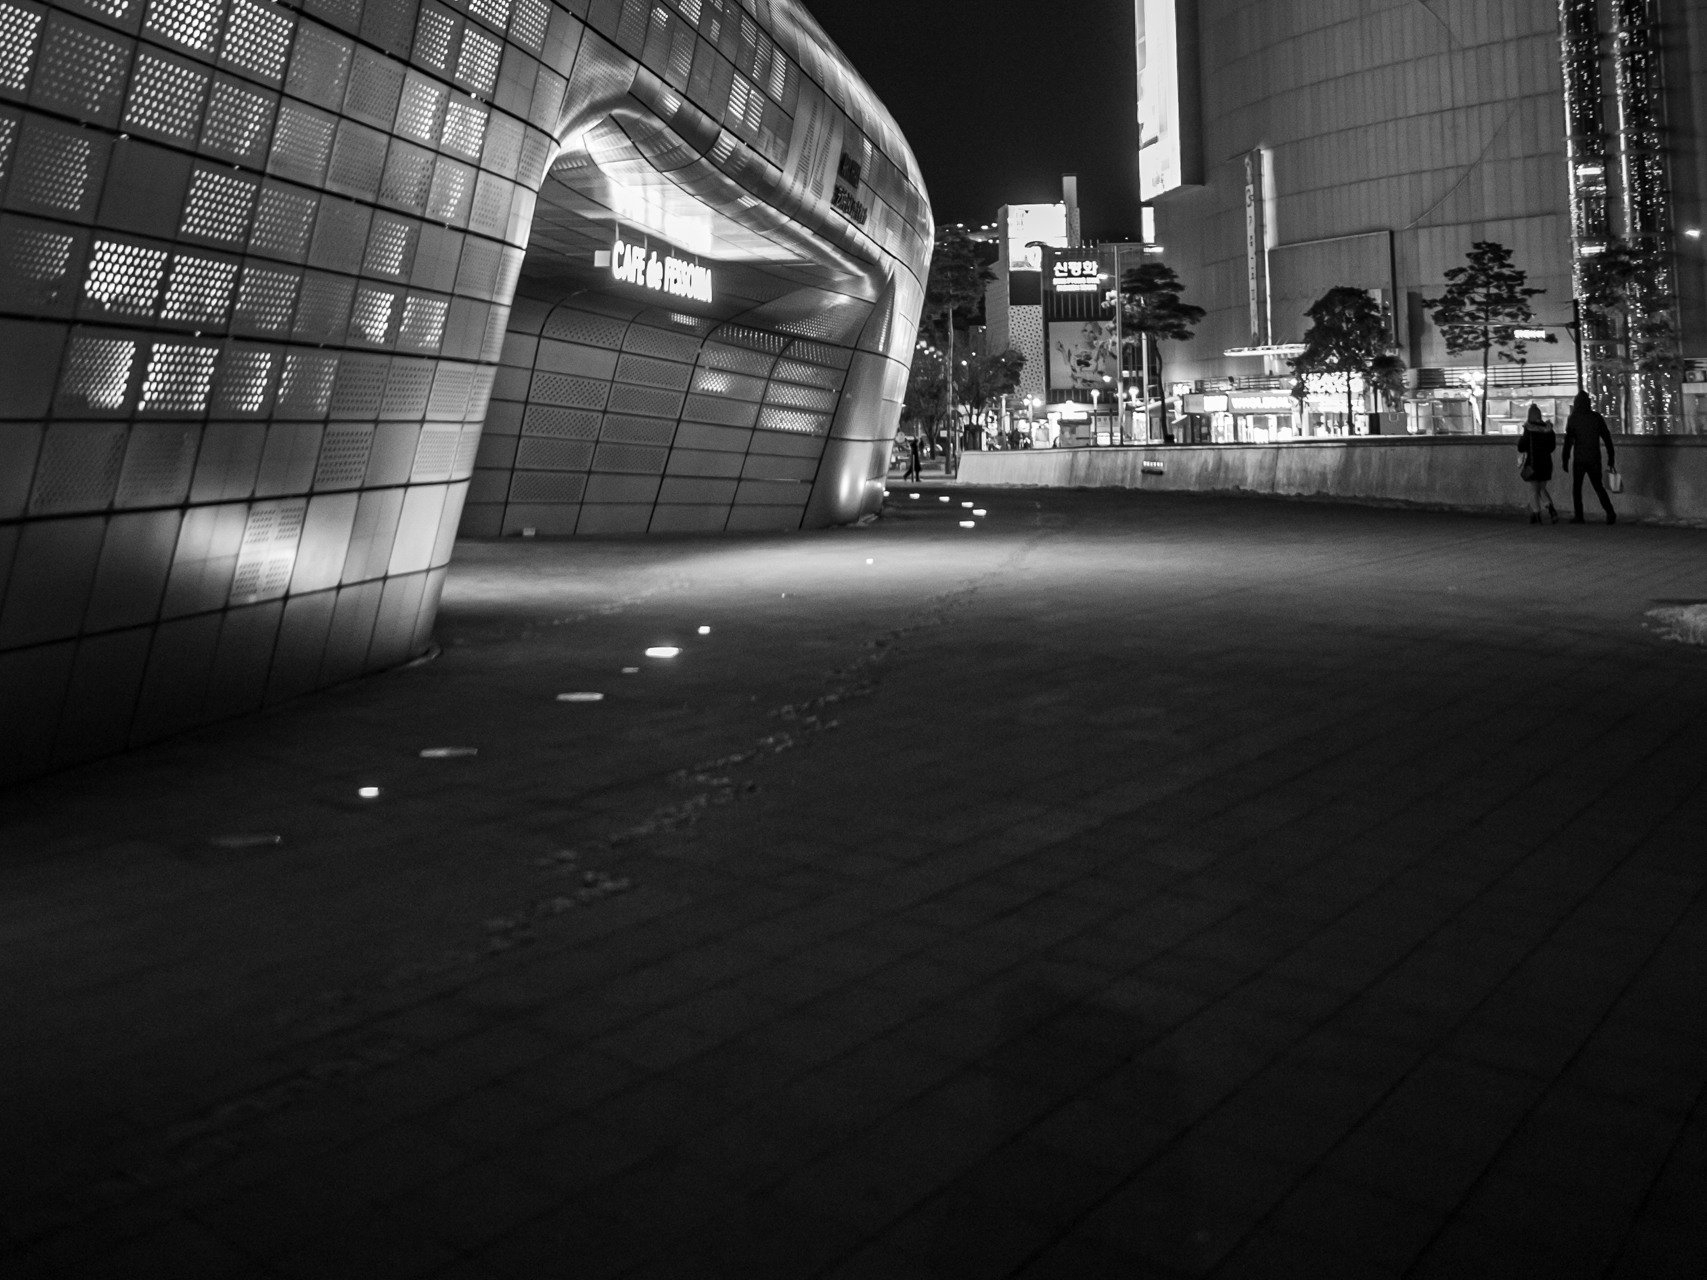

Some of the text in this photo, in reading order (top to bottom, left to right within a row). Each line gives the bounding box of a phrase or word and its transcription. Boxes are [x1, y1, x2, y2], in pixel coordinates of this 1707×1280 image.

[612, 240, 646, 286] CAFE
[646, 251, 663, 290] de
[1053, 261, 1099, 276] 신평화
